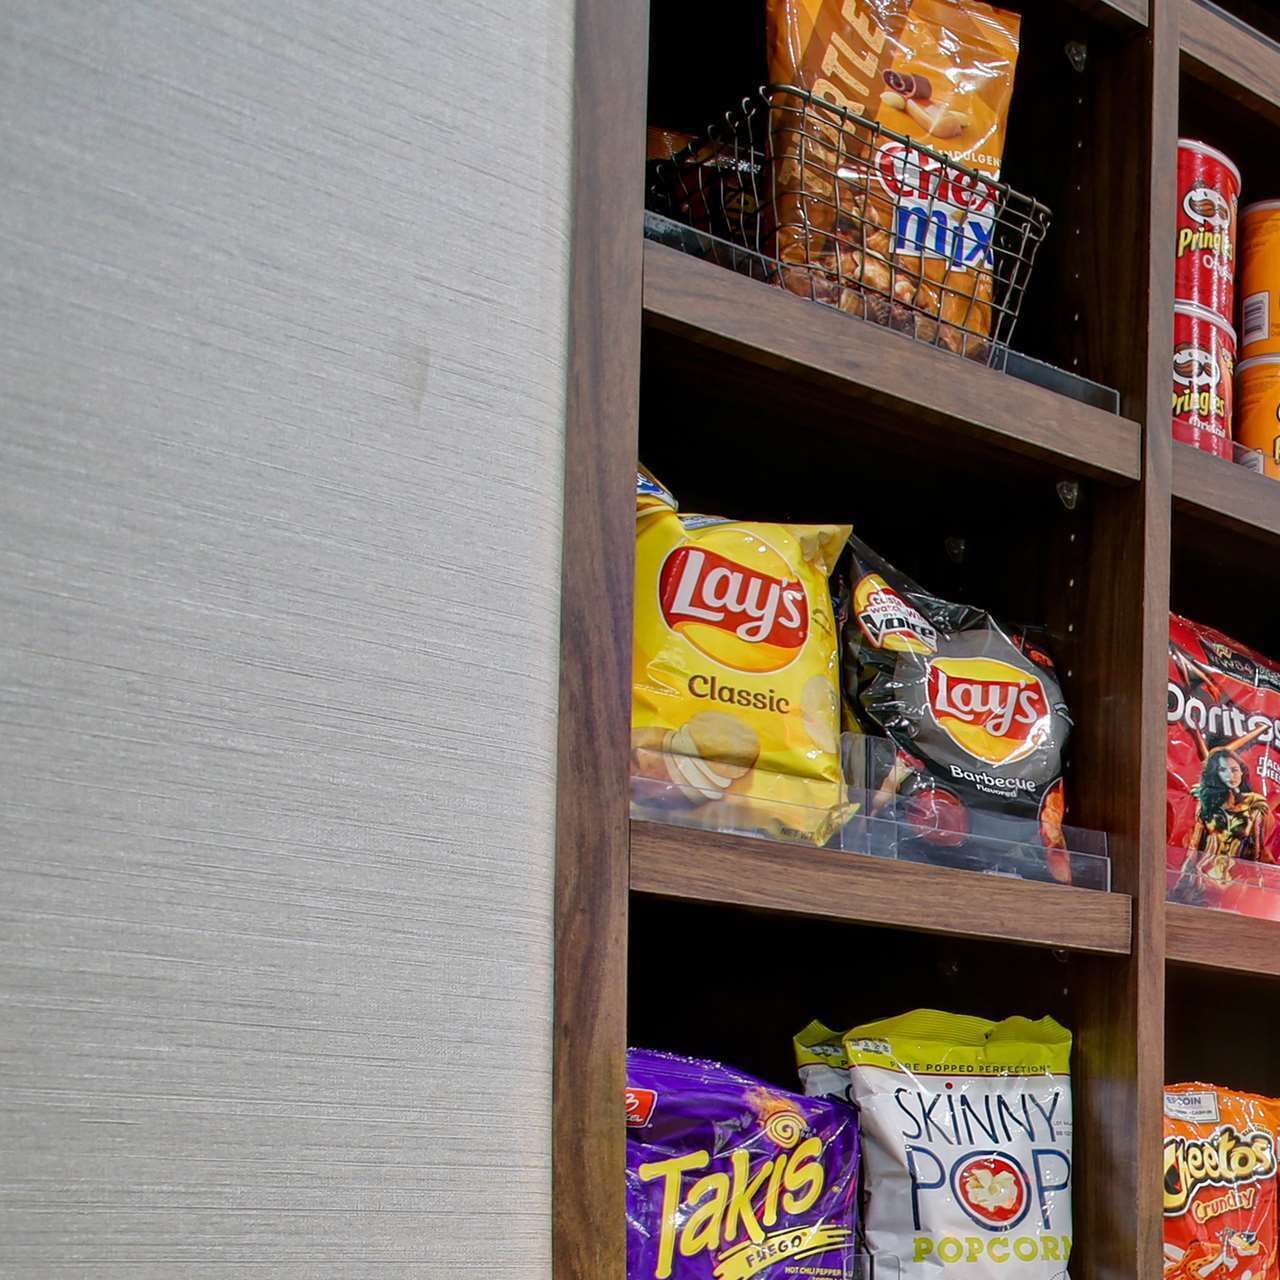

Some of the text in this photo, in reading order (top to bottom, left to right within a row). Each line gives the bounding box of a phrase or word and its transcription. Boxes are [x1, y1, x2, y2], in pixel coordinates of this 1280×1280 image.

[669, 548, 804, 643] Lay's
[687, 674, 791, 715] Classic
[934, 671, 1044, 737] Lay's
[949, 764, 1037, 793] Barbecue
[926, 1063, 974, 1073] POPPED
[639, 1137, 825, 1280] Takis
[905, 1147, 1072, 1233] POP
[745, 1234, 803, 1268] FUEGO
